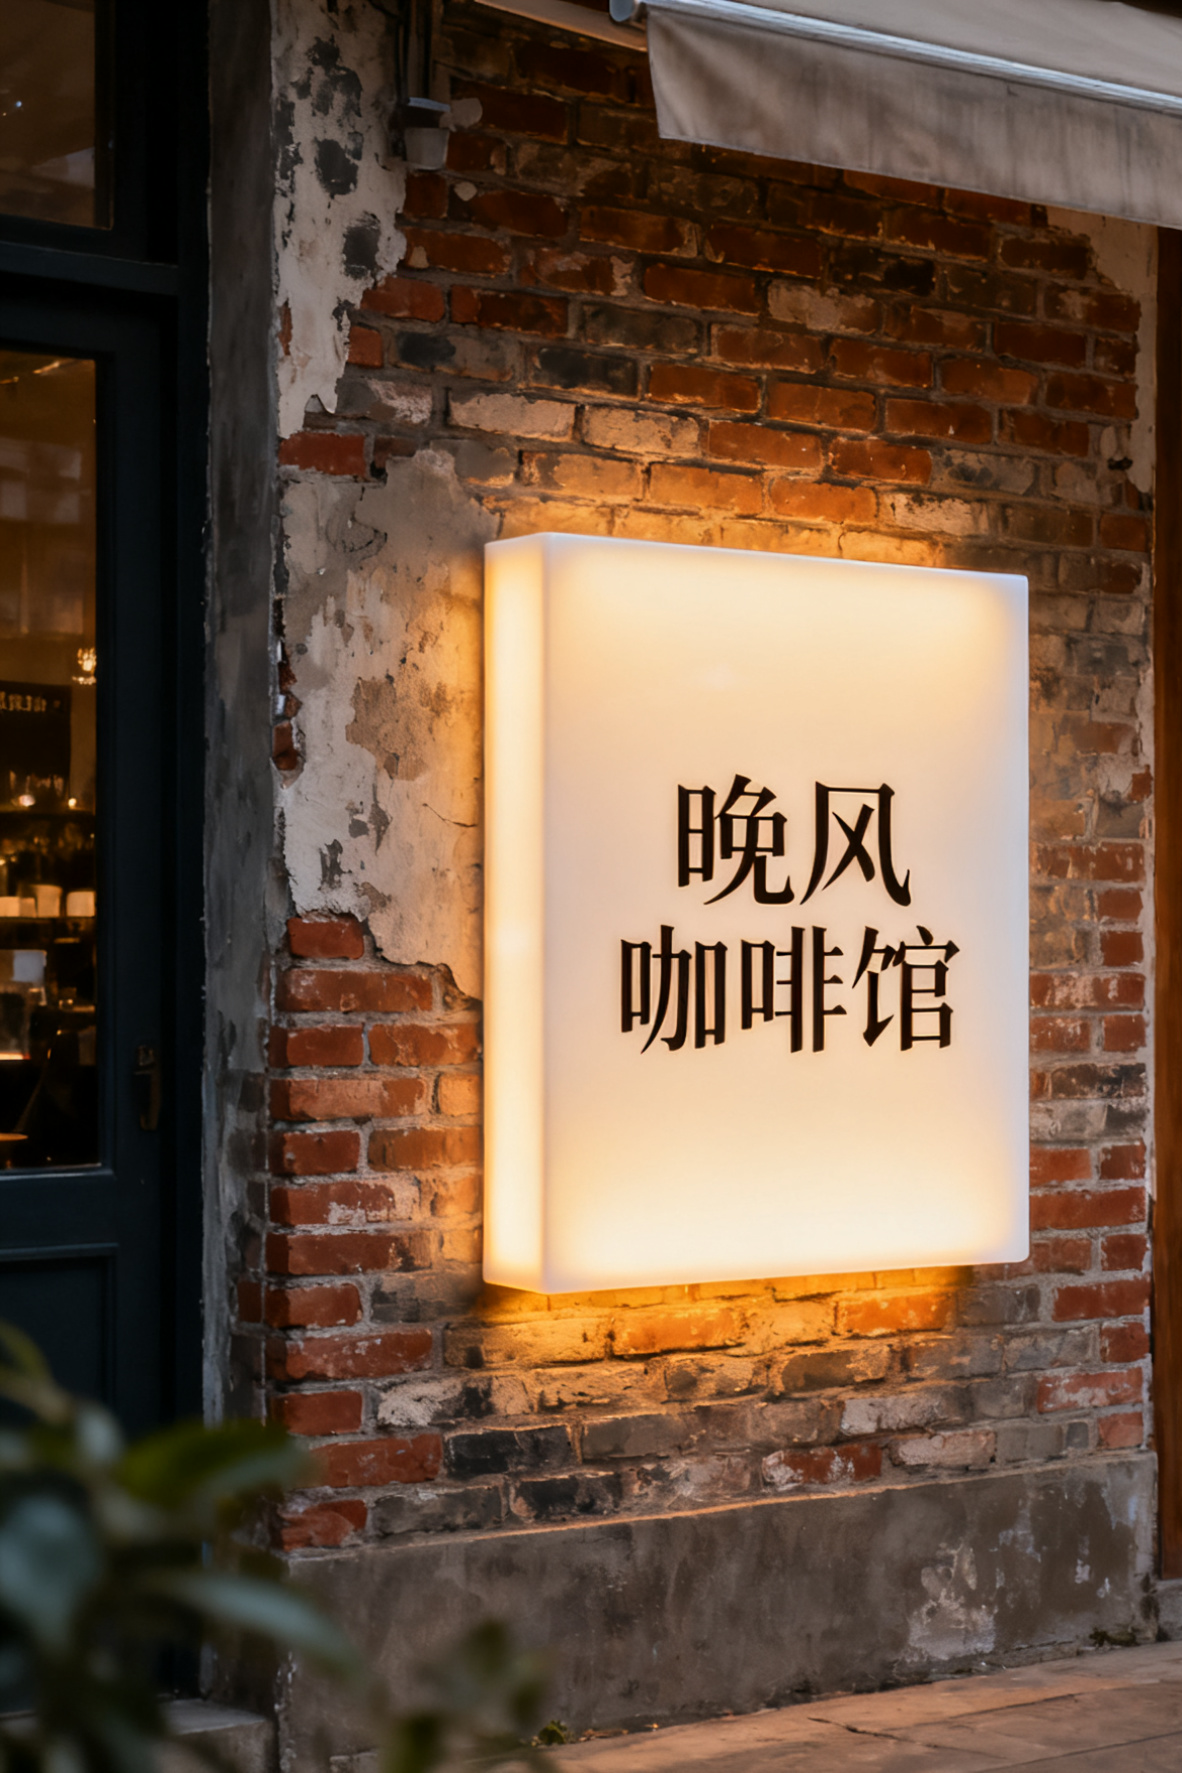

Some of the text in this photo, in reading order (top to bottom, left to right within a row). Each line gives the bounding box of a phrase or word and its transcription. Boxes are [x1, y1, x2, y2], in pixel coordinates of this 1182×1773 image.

[677, 773, 912, 907] 晚风
[620, 924, 960, 1054] 咖啡馆
